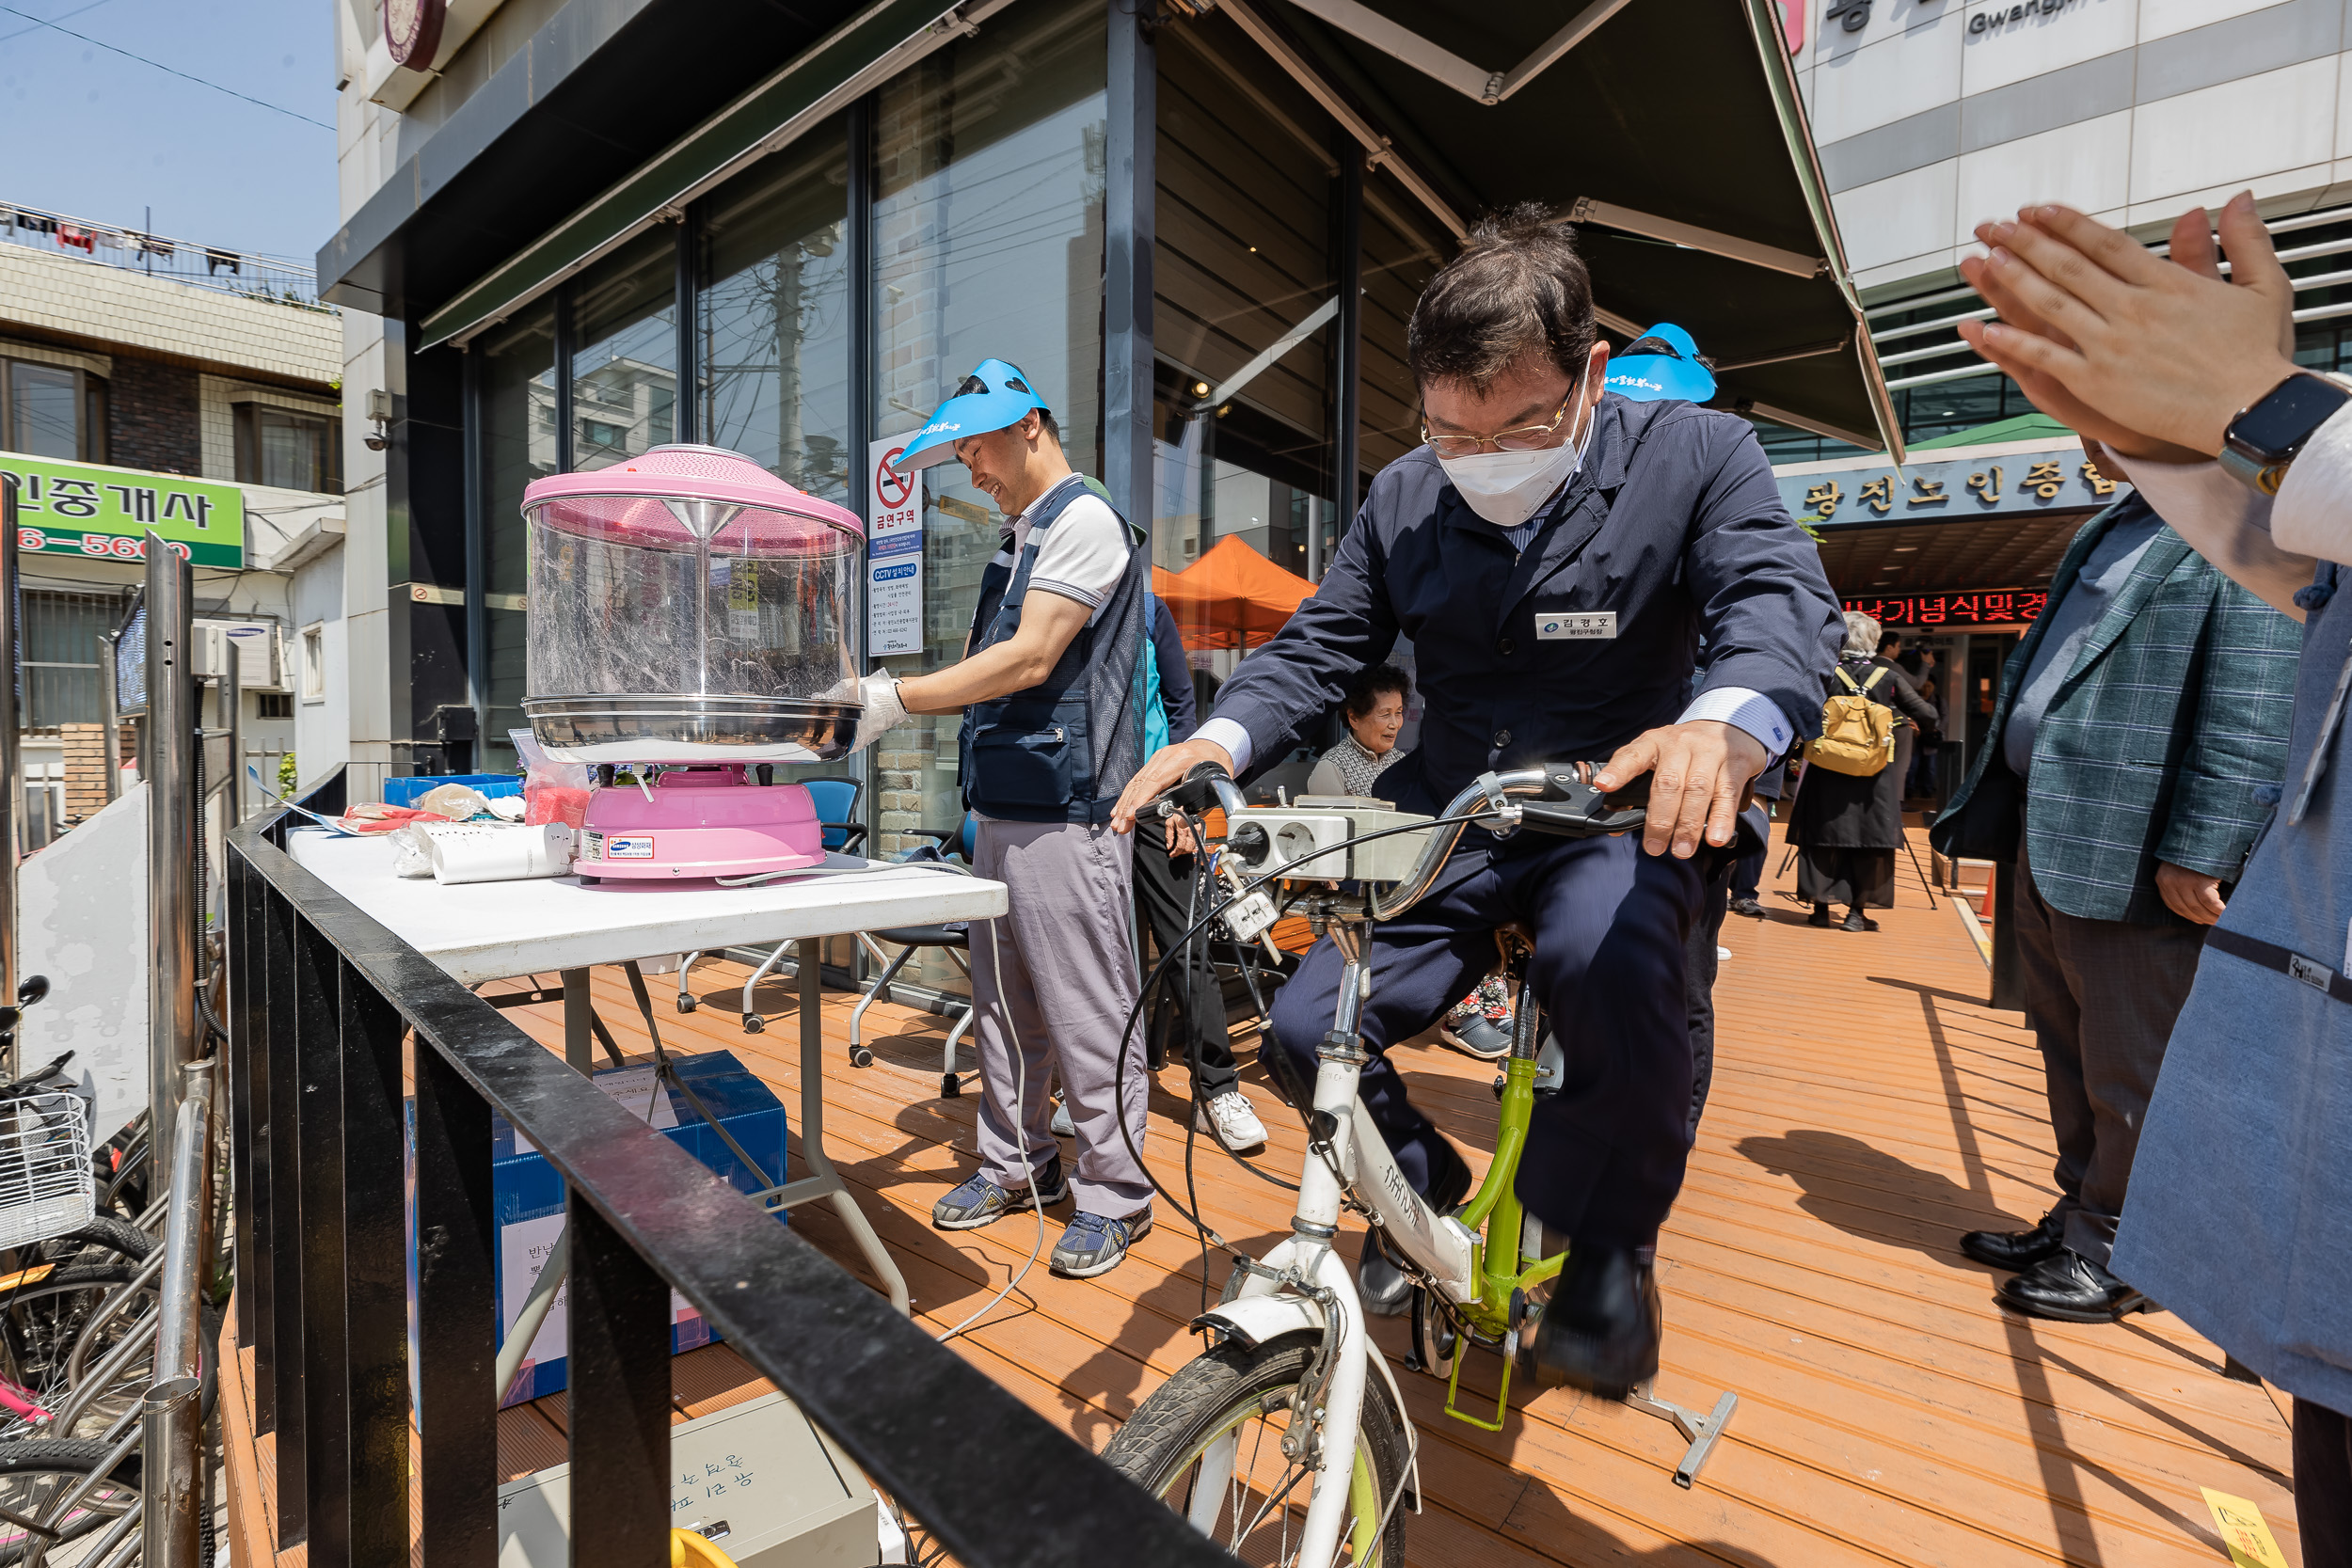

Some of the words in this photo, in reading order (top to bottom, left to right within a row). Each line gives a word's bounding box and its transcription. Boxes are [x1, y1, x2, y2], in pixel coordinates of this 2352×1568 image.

[877, 509, 914, 531] 금연구역
[875, 569, 892, 580] CCTV
[892, 565, 915, 578] 설치안내
